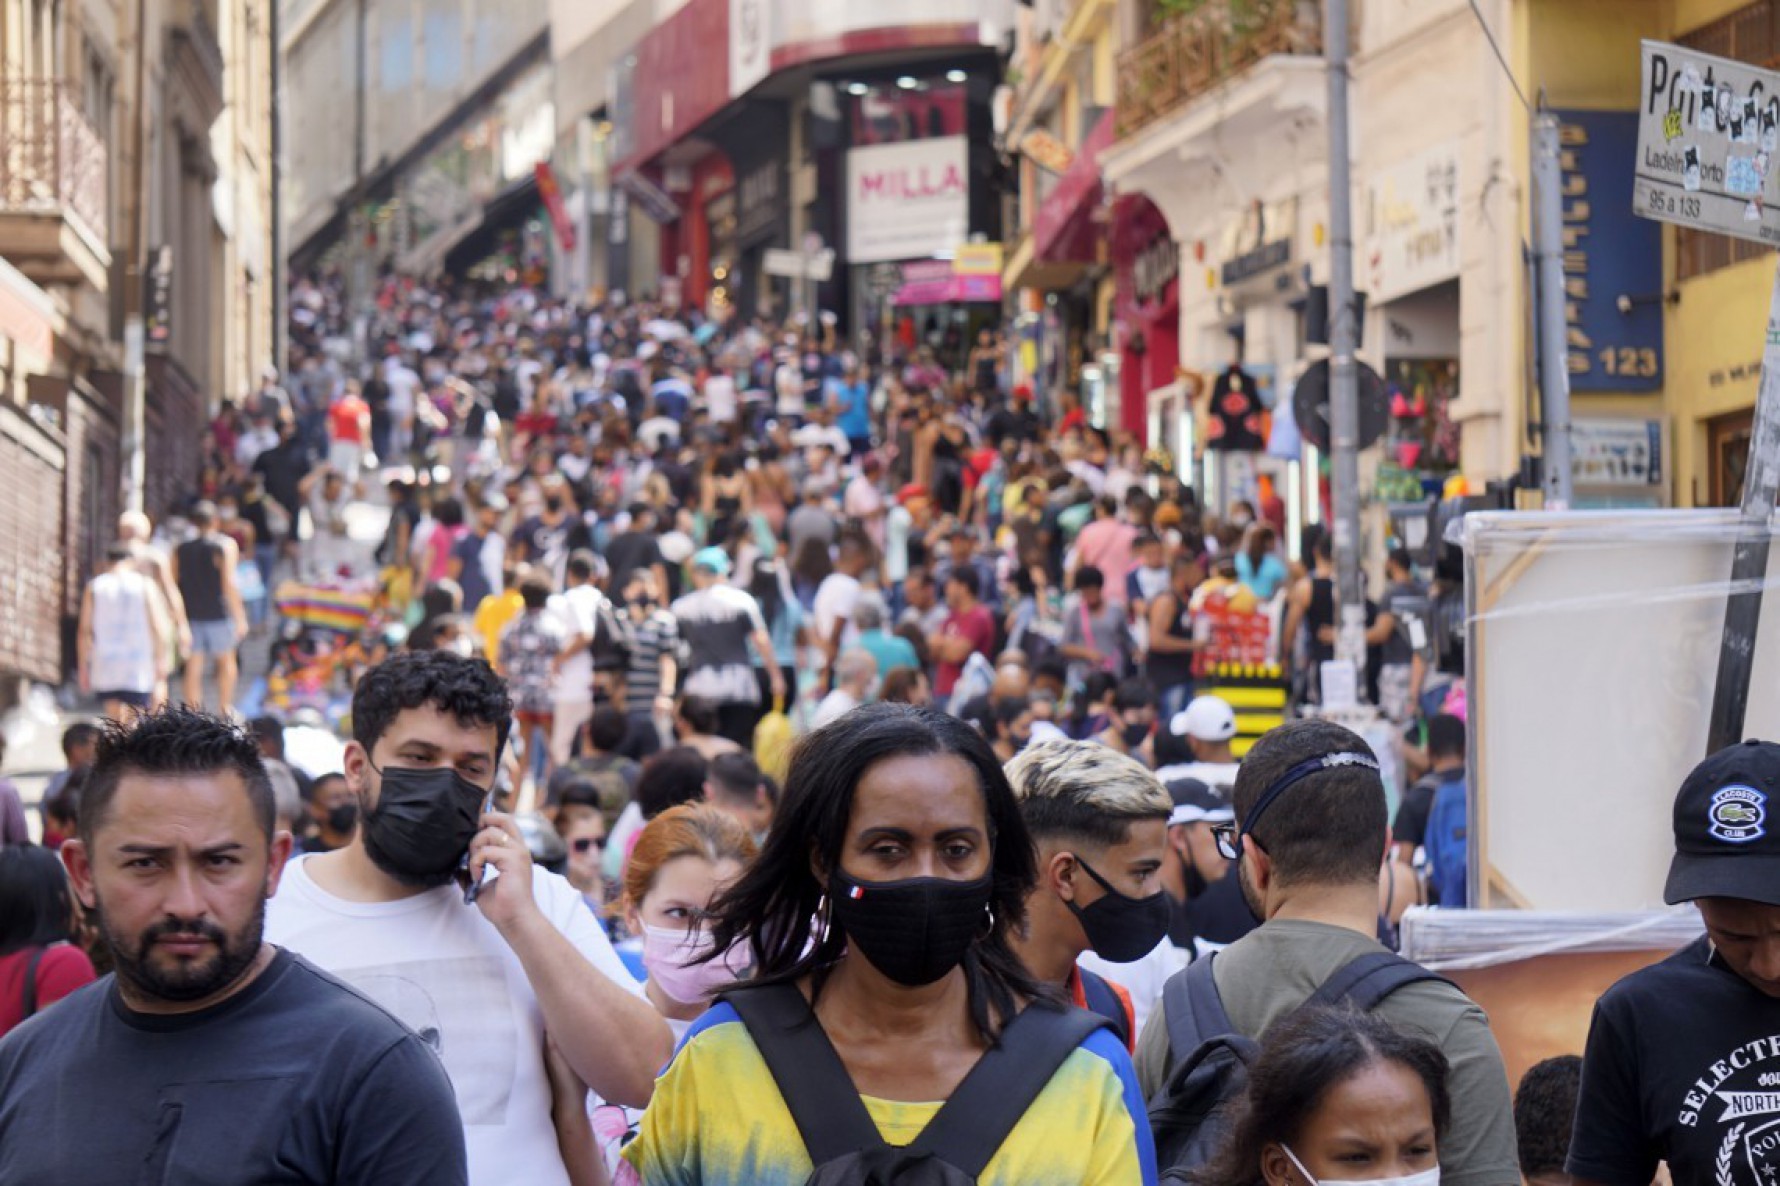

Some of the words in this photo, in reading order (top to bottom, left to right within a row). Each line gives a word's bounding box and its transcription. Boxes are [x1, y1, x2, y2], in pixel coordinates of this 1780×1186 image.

[1645, 145, 1688, 175] Ladeir
[1695, 159, 1723, 183] orto
[860, 163, 966, 201] MILLA
[1650, 191, 1664, 210] 95
[1667, 198, 1676, 212] a
[1679, 196, 1700, 218] 133
[1600, 346, 1658, 377] 123
[1719, 789, 1757, 801] LACOSTE
[1723, 829, 1746, 838] CLUB
